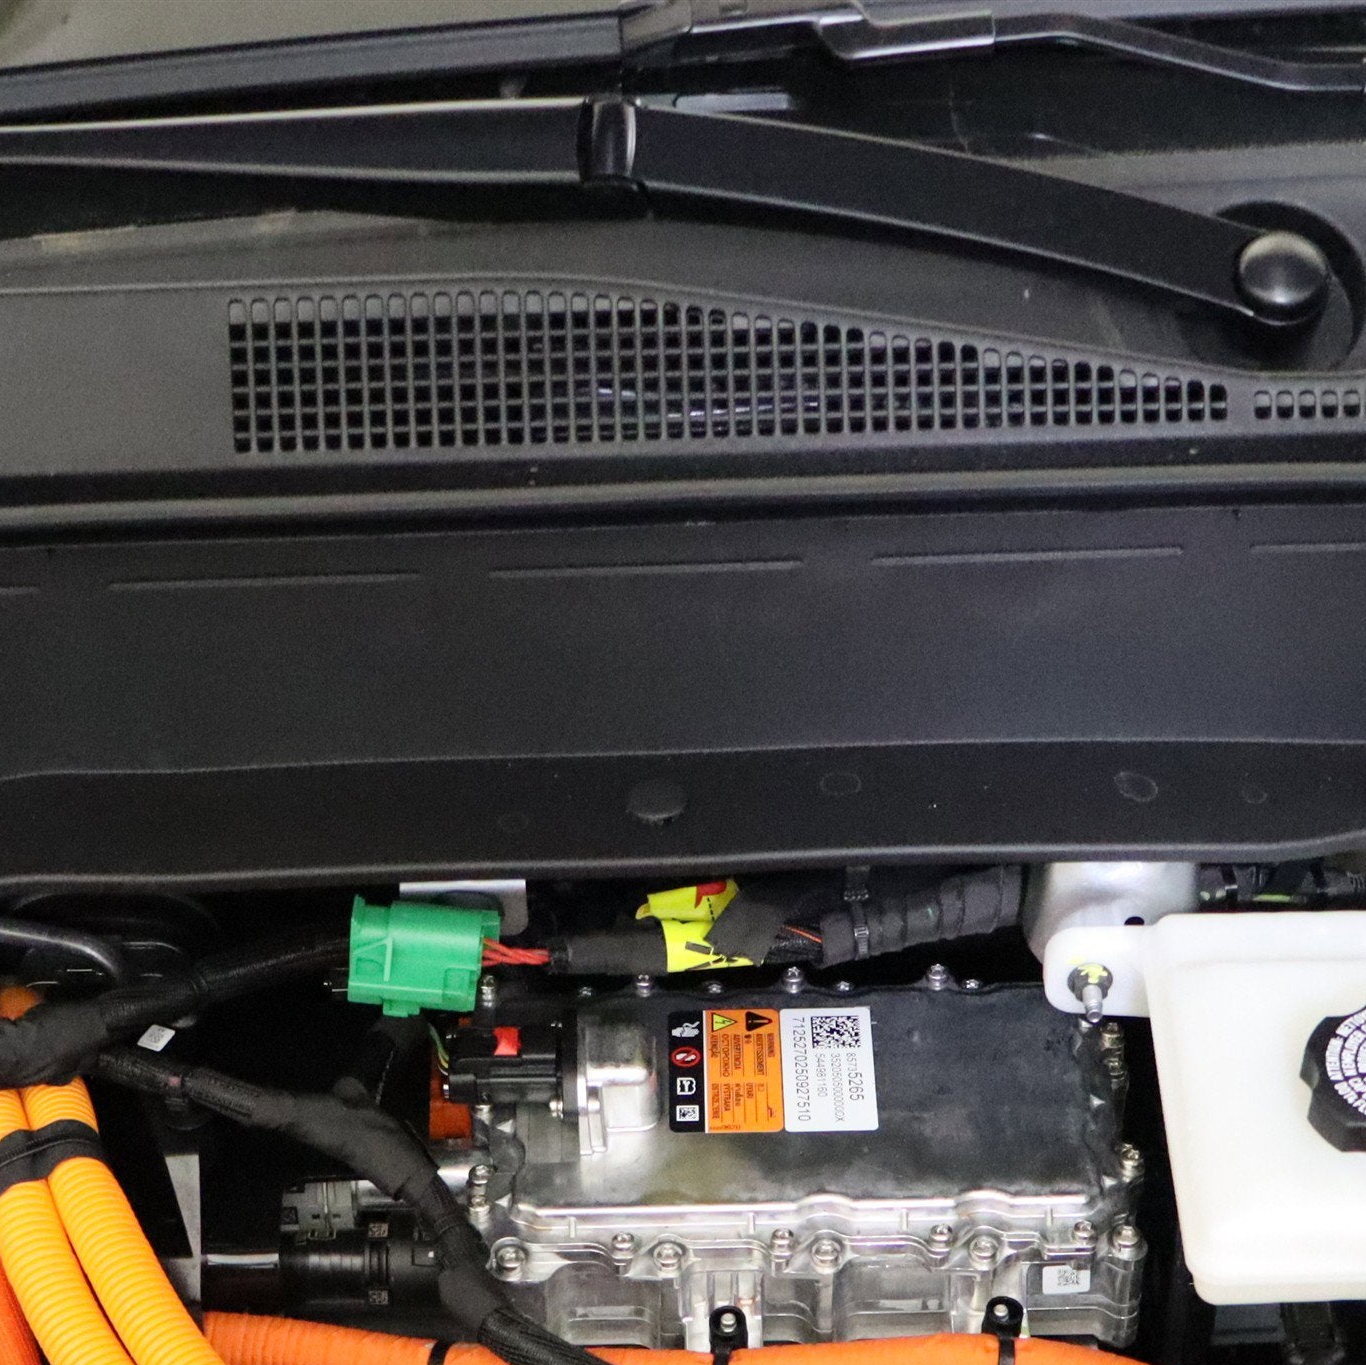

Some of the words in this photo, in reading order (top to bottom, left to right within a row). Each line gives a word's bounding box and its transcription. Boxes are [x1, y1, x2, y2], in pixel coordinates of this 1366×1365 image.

[721, 1033, 731, 1078] ОСТОРОЖНО
[846, 1052, 866, 1102] 85735265
[746, 1082, 754, 1100] UYARI
